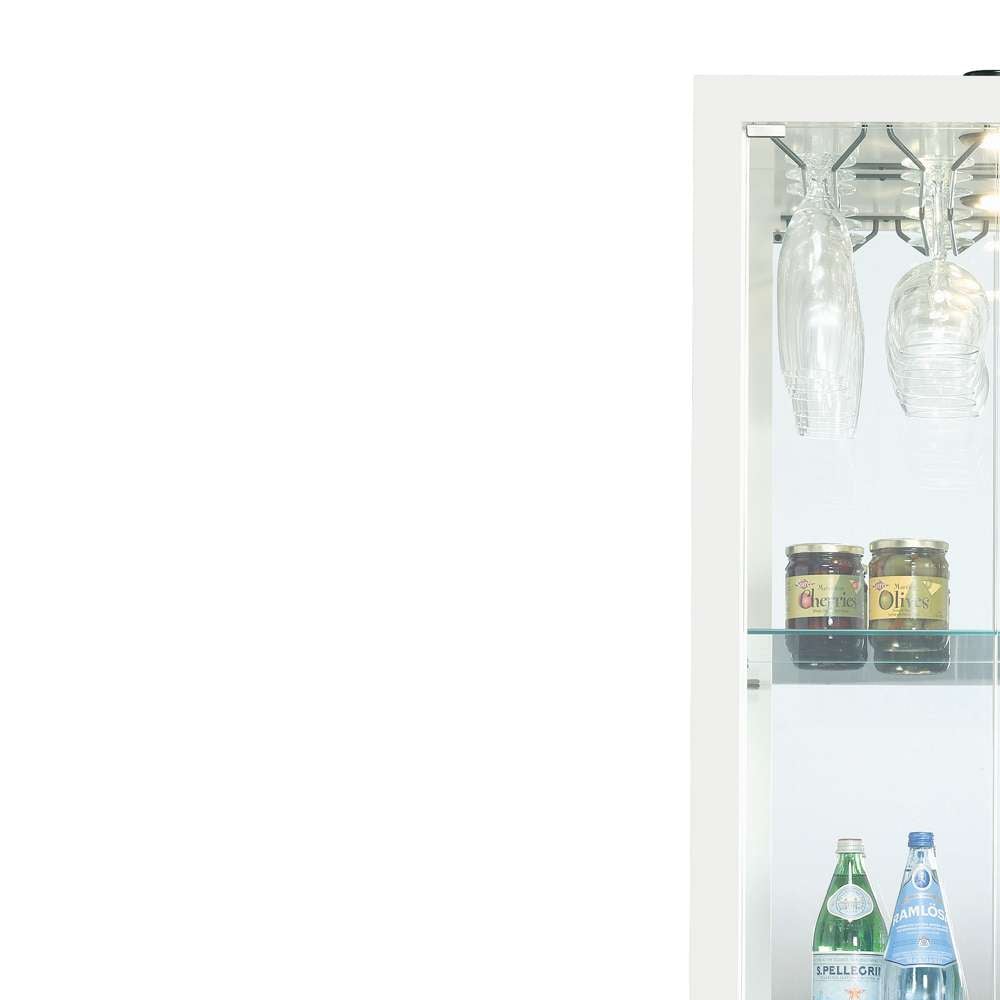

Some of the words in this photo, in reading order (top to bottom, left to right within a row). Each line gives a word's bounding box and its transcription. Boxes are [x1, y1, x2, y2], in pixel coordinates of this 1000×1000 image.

[800, 589, 857, 609] Cherries
[879, 589, 929, 611] Olives
[893, 903, 948, 927] RAMLÖS
